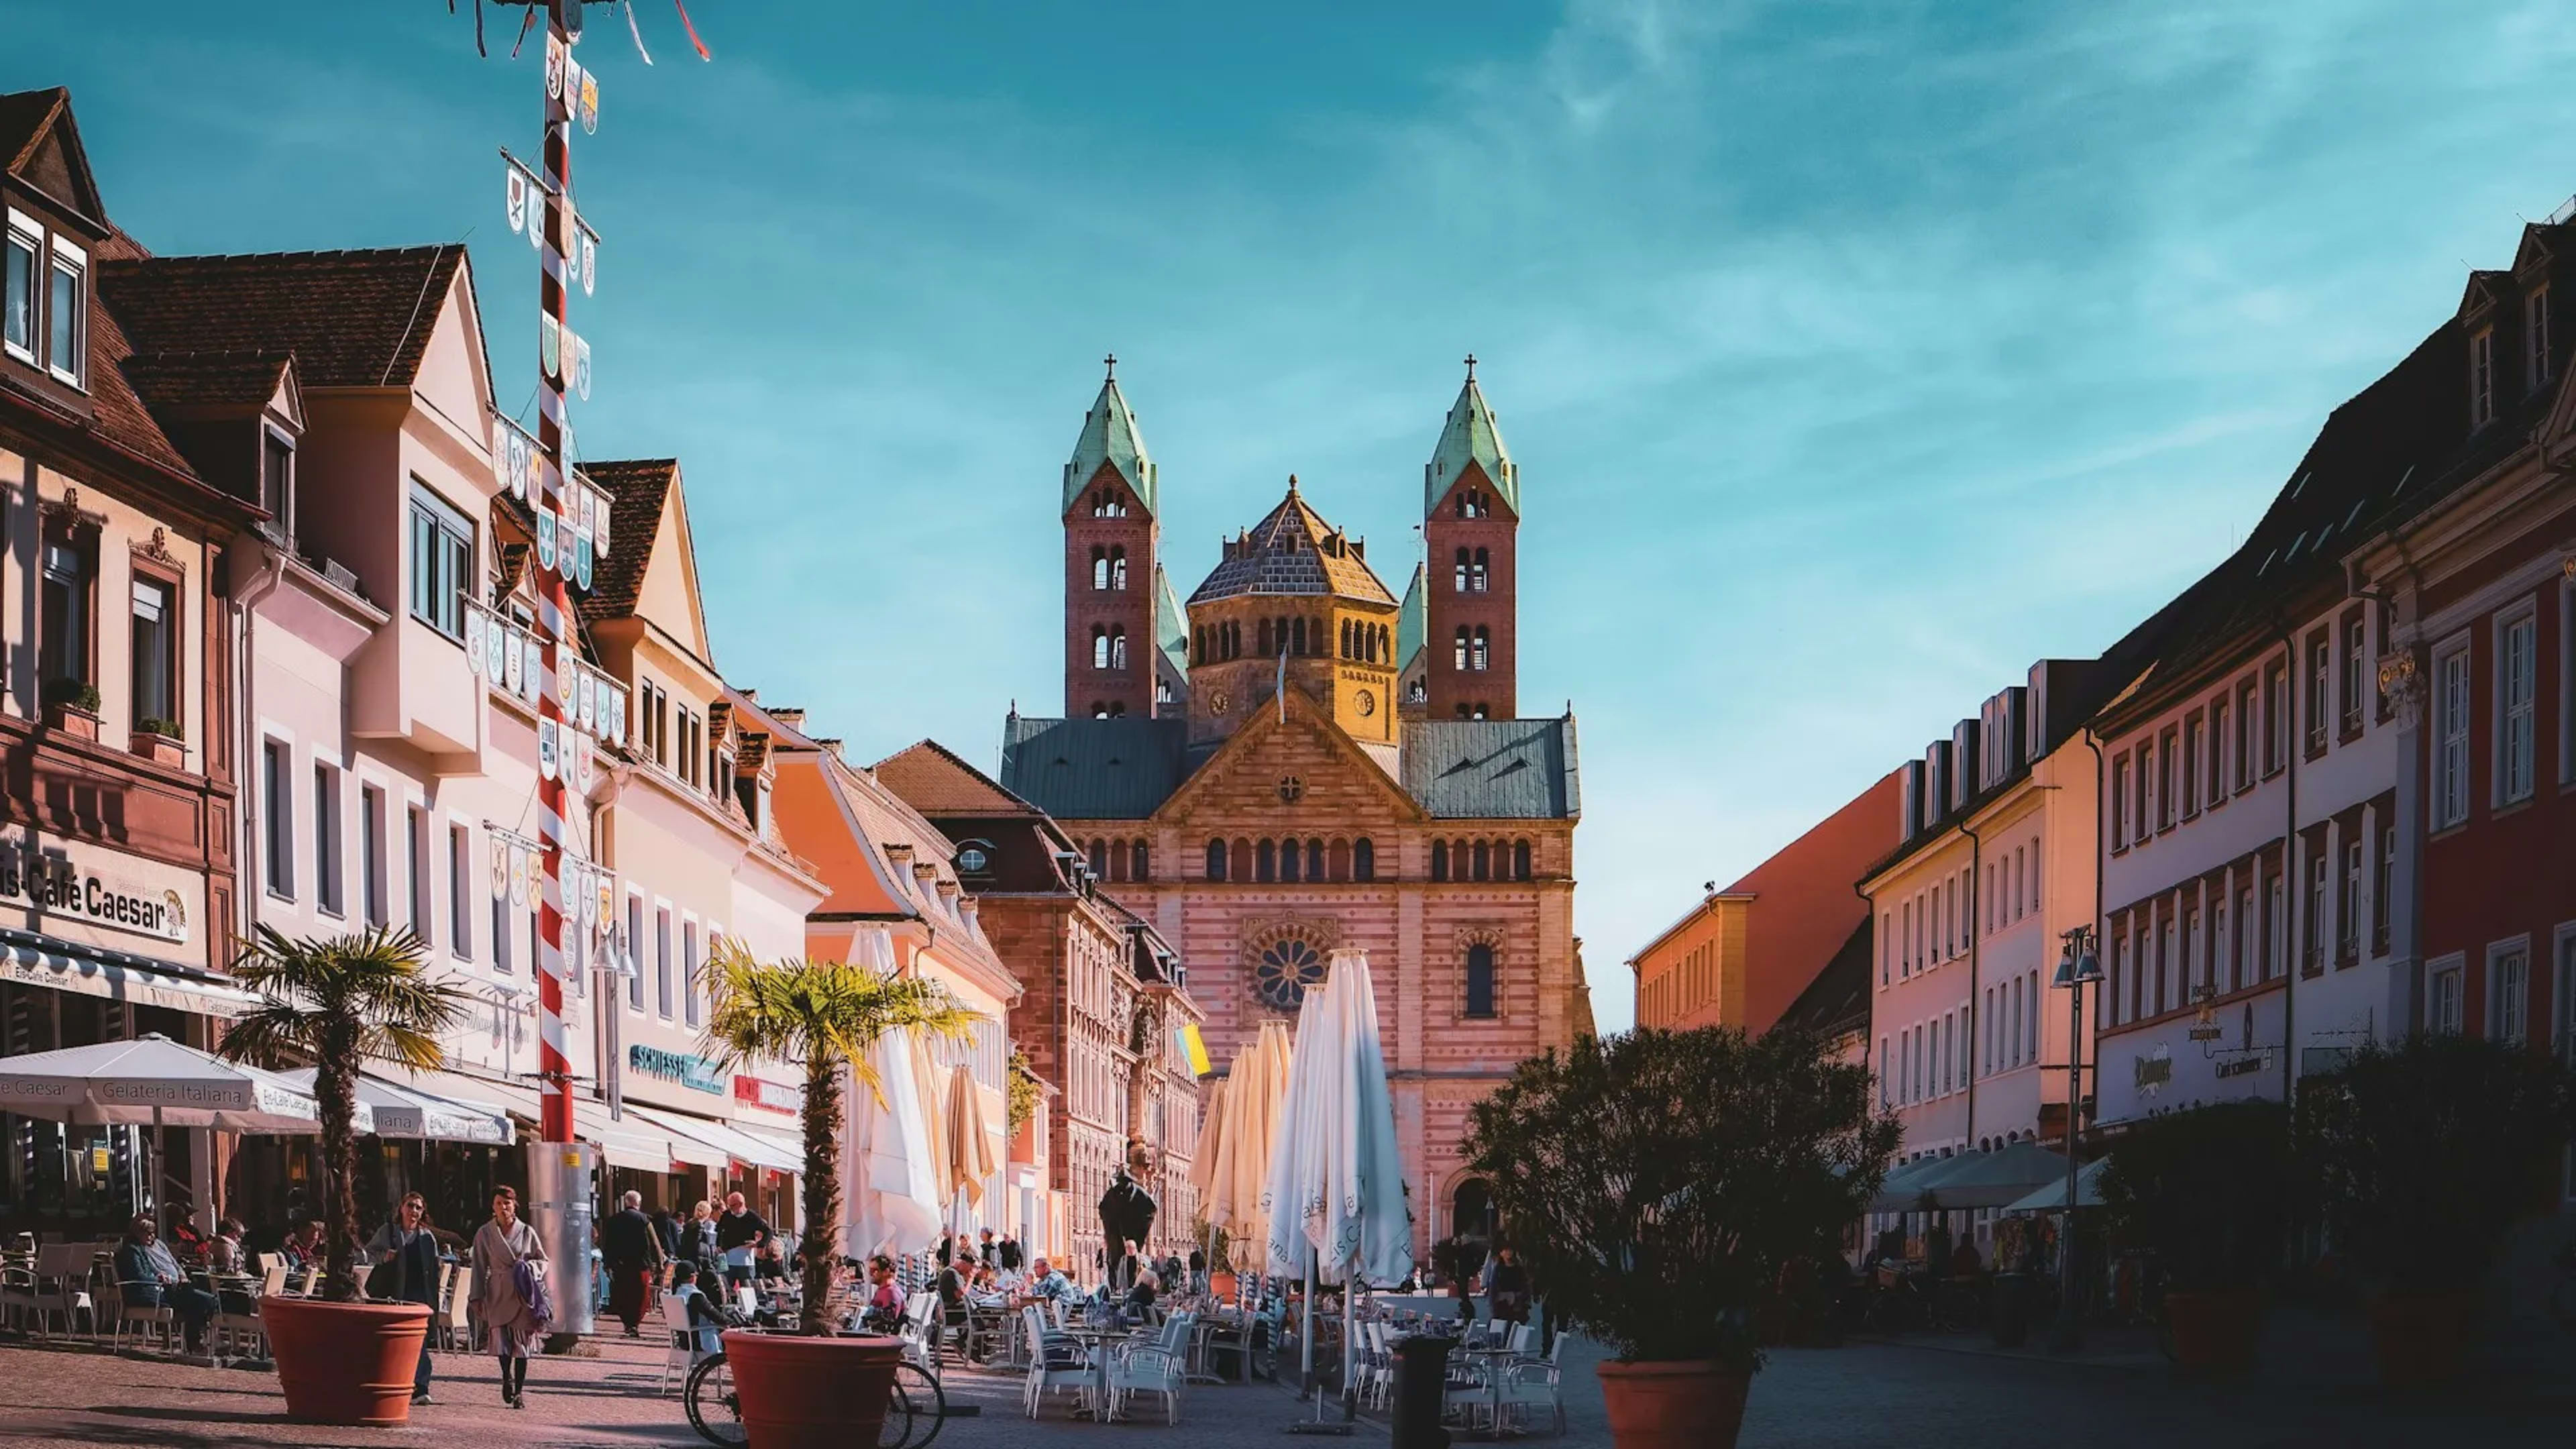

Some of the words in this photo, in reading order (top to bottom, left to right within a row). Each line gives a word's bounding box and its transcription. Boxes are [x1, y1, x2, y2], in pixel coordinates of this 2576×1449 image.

[86, 877, 165, 930] Caesar
[45, 972, 68, 986] Caesar
[15, 1079, 68, 1095] Caesar
[103, 1082, 175, 1099] Gelateria
[182, 1085, 241, 1103] Italiana
